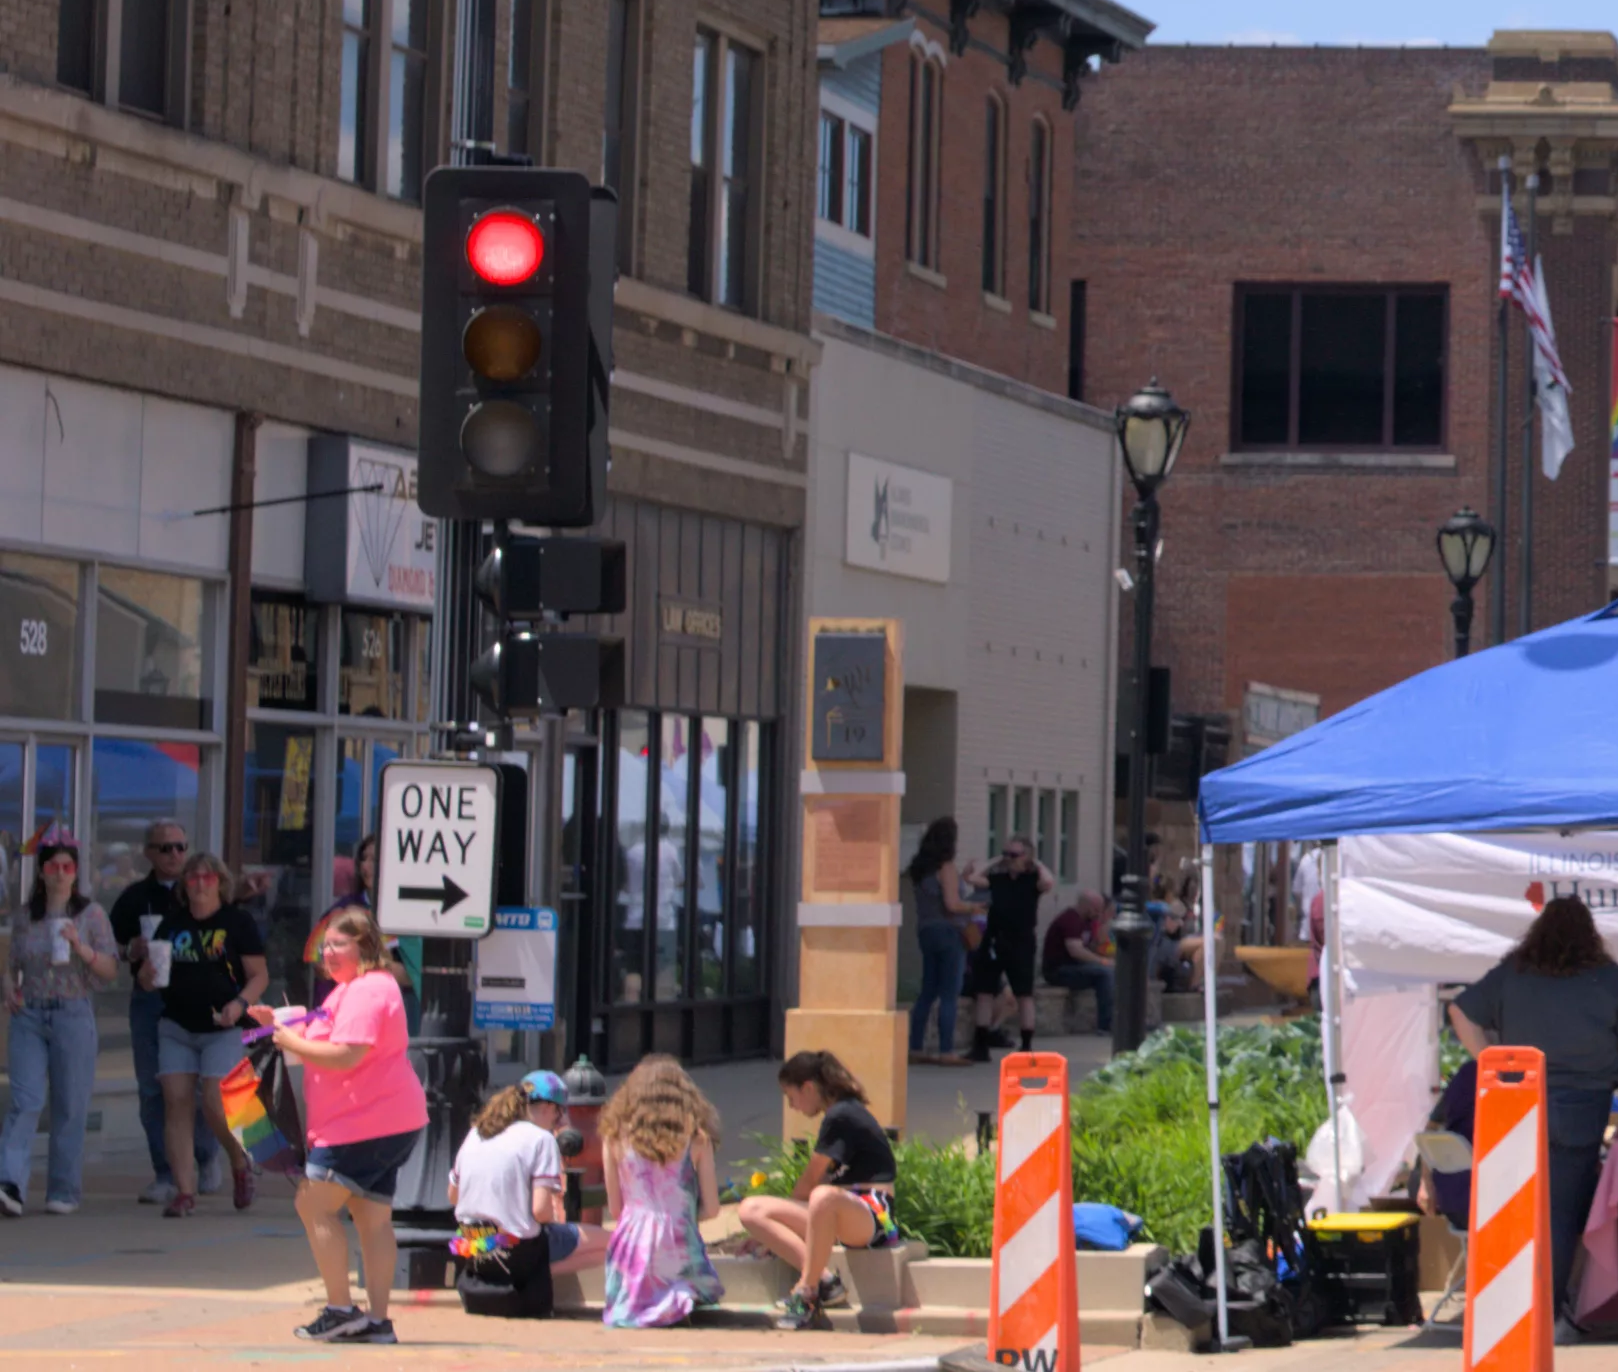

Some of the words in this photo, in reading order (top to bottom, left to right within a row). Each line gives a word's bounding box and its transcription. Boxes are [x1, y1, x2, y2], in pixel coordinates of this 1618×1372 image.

[20, 618, 47, 656] 528
[361, 629, 381, 658] 526
[401, 783, 476, 820] ONE
[397, 828, 477, 866] WAY
